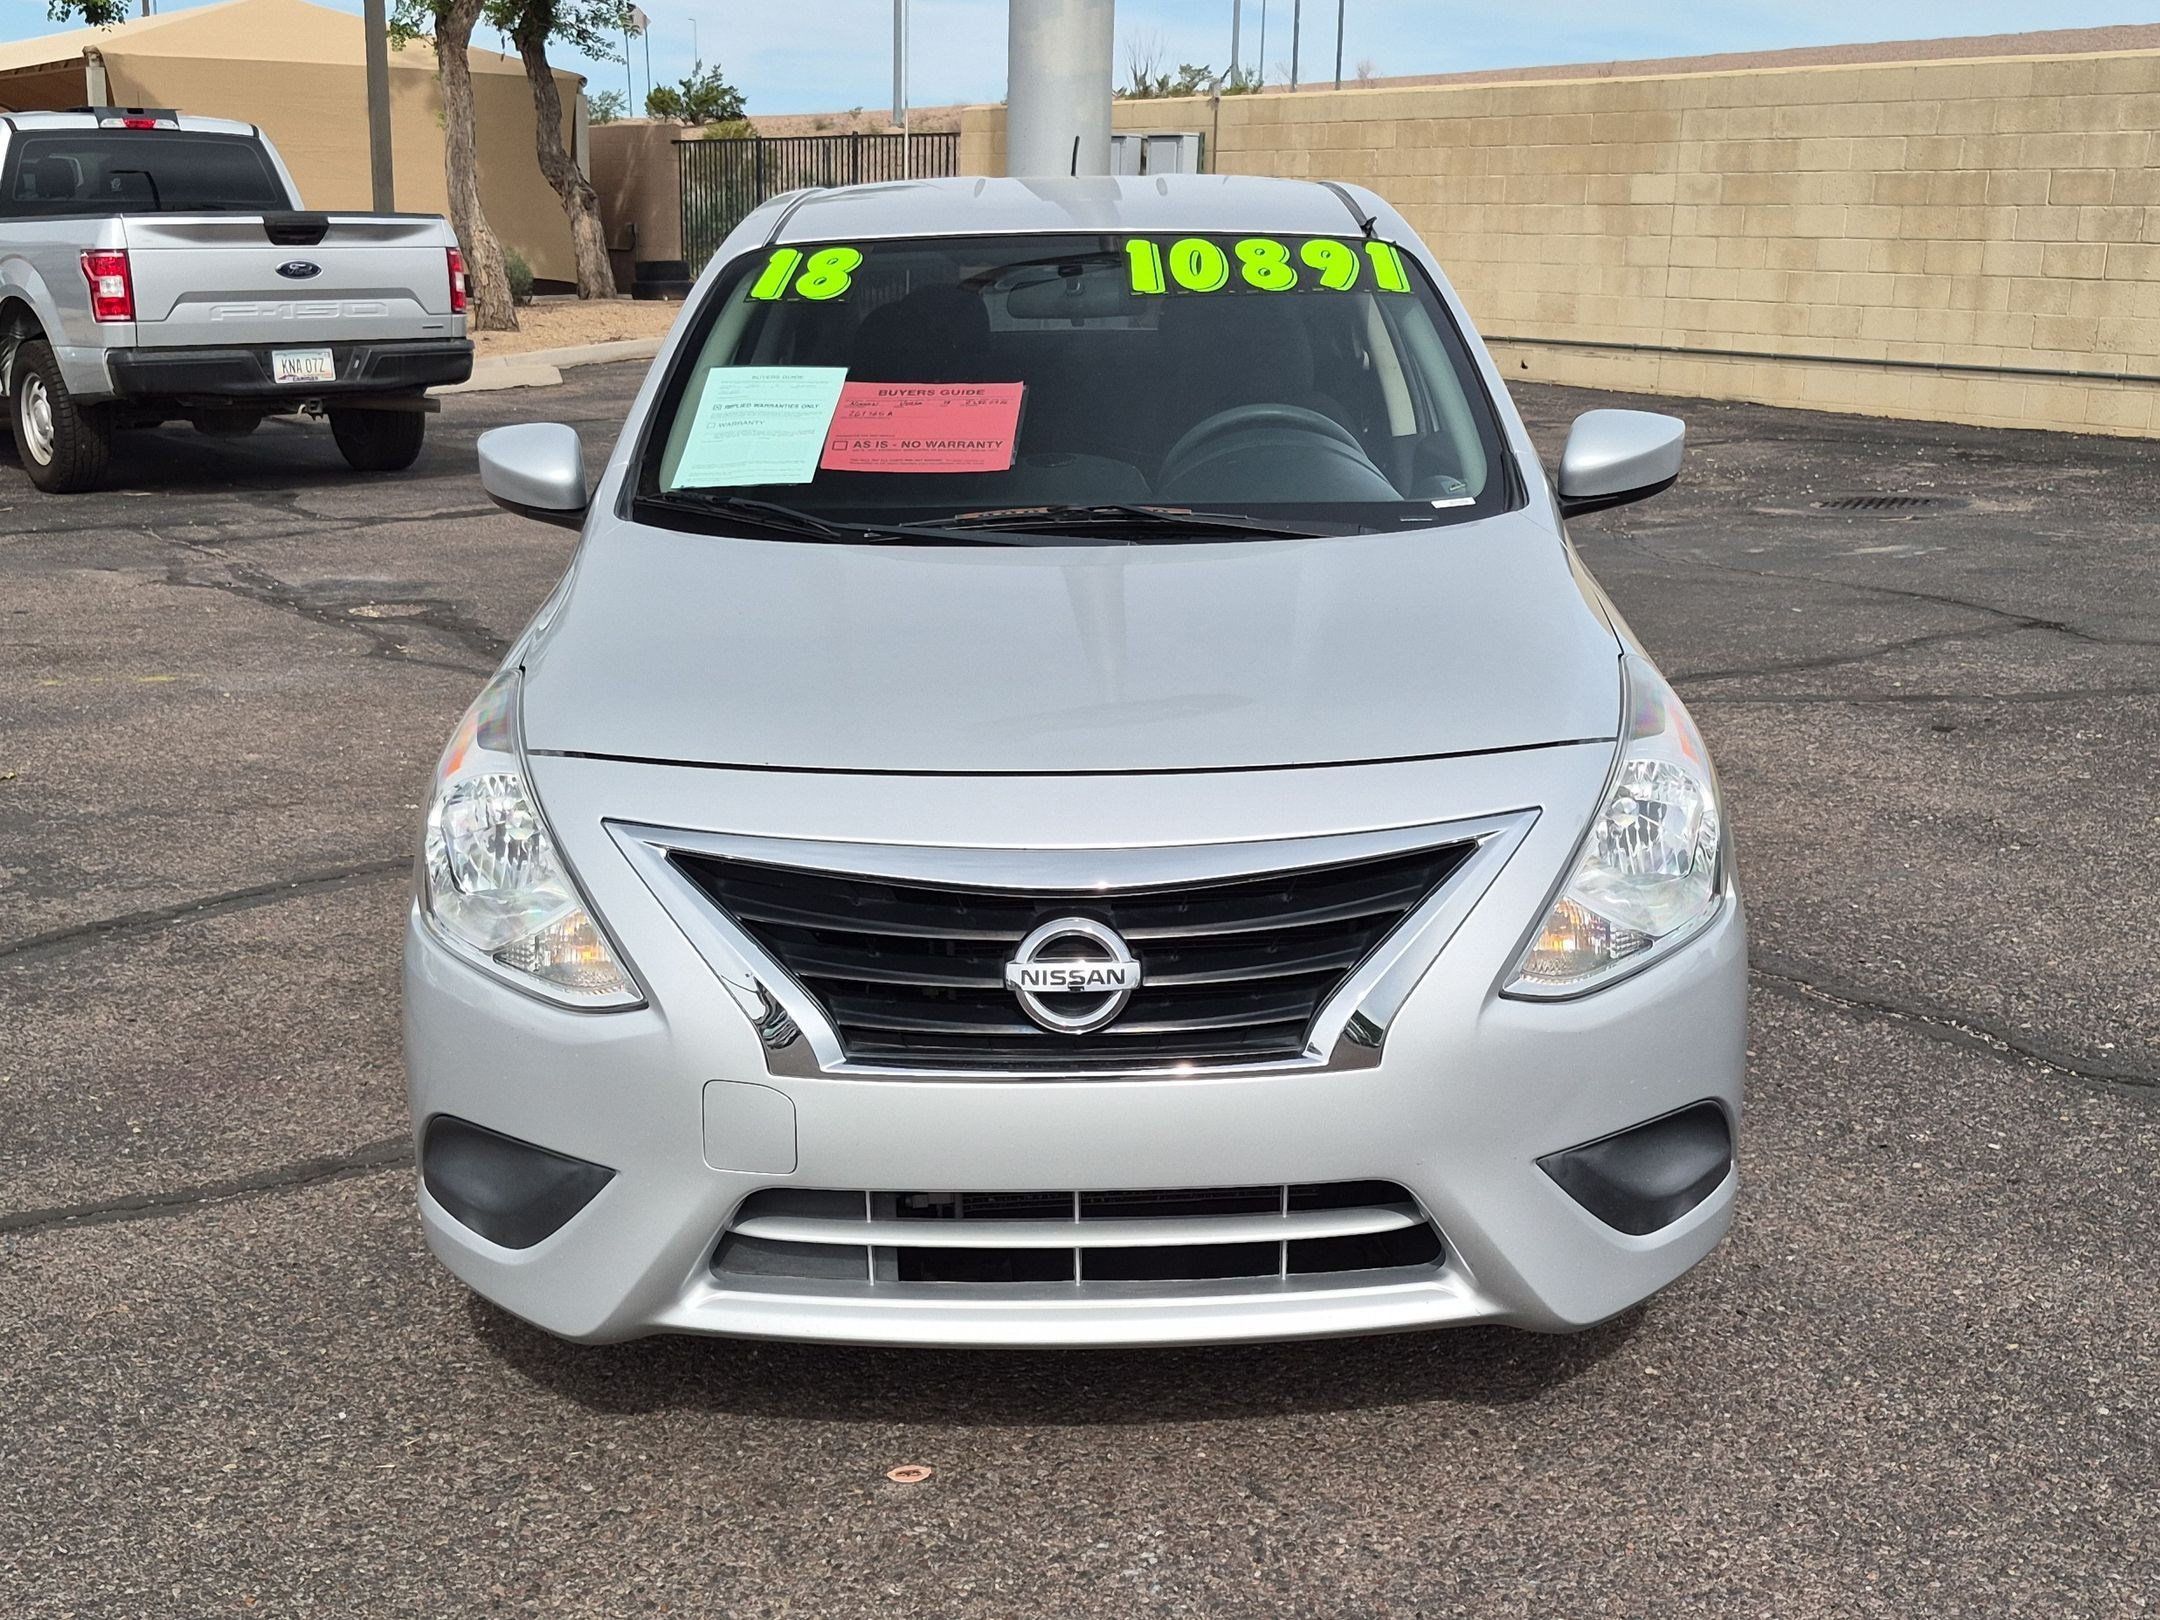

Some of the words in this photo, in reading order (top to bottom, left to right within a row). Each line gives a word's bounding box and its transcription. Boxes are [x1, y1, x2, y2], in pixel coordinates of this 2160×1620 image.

[1126, 238, 1410, 293] 10891
[751, 248, 863, 300] 18
[209, 302, 388, 321] F-150
[281, 358, 302, 373] KNA
[878, 389, 935, 397] BUYERS
[718, 420, 765, 428] WARRANTY
[852, 440, 871, 449] AS
[875, 440, 888, 449] IS
[901, 440, 921, 449] NO
[924, 440, 1004, 449] WARRANTY
[1020, 968, 1126, 986] NISSAN
